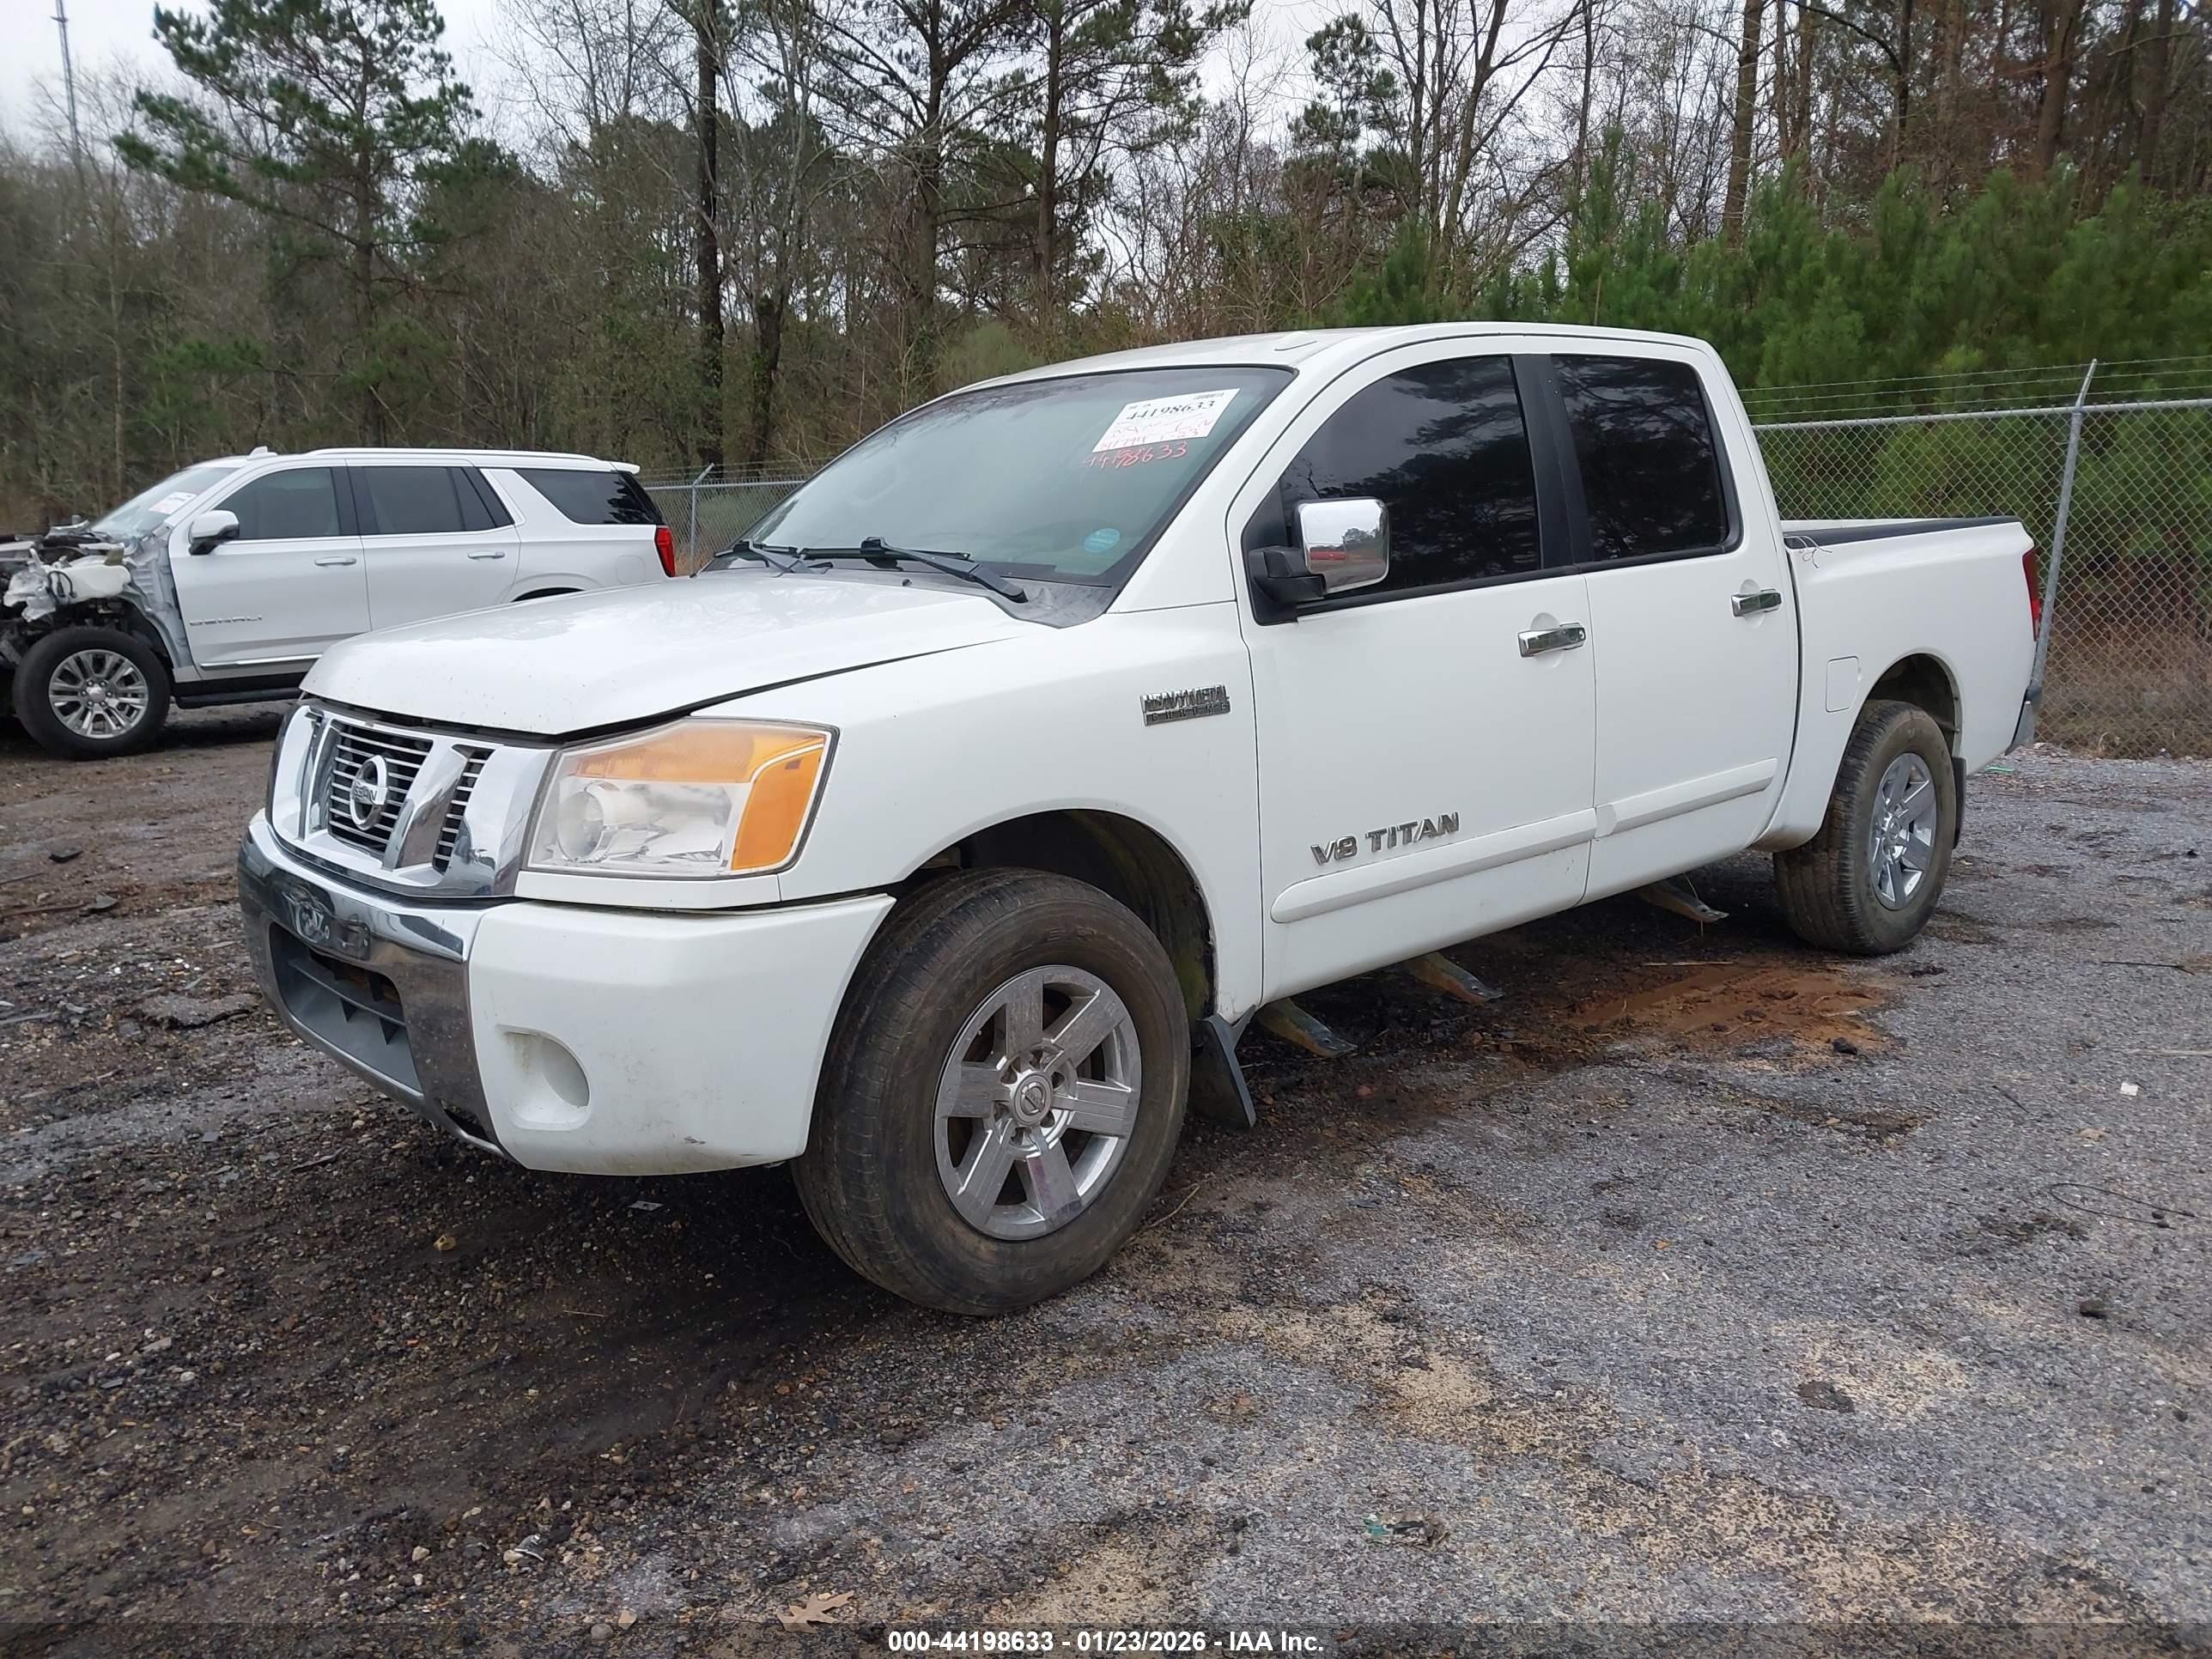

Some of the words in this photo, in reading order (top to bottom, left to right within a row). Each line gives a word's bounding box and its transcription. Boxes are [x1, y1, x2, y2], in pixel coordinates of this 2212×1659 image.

[1127, 400, 1215, 420] 44198633
[1310, 835, 1358, 866] V8
[1365, 811, 1460, 853] TITAN
